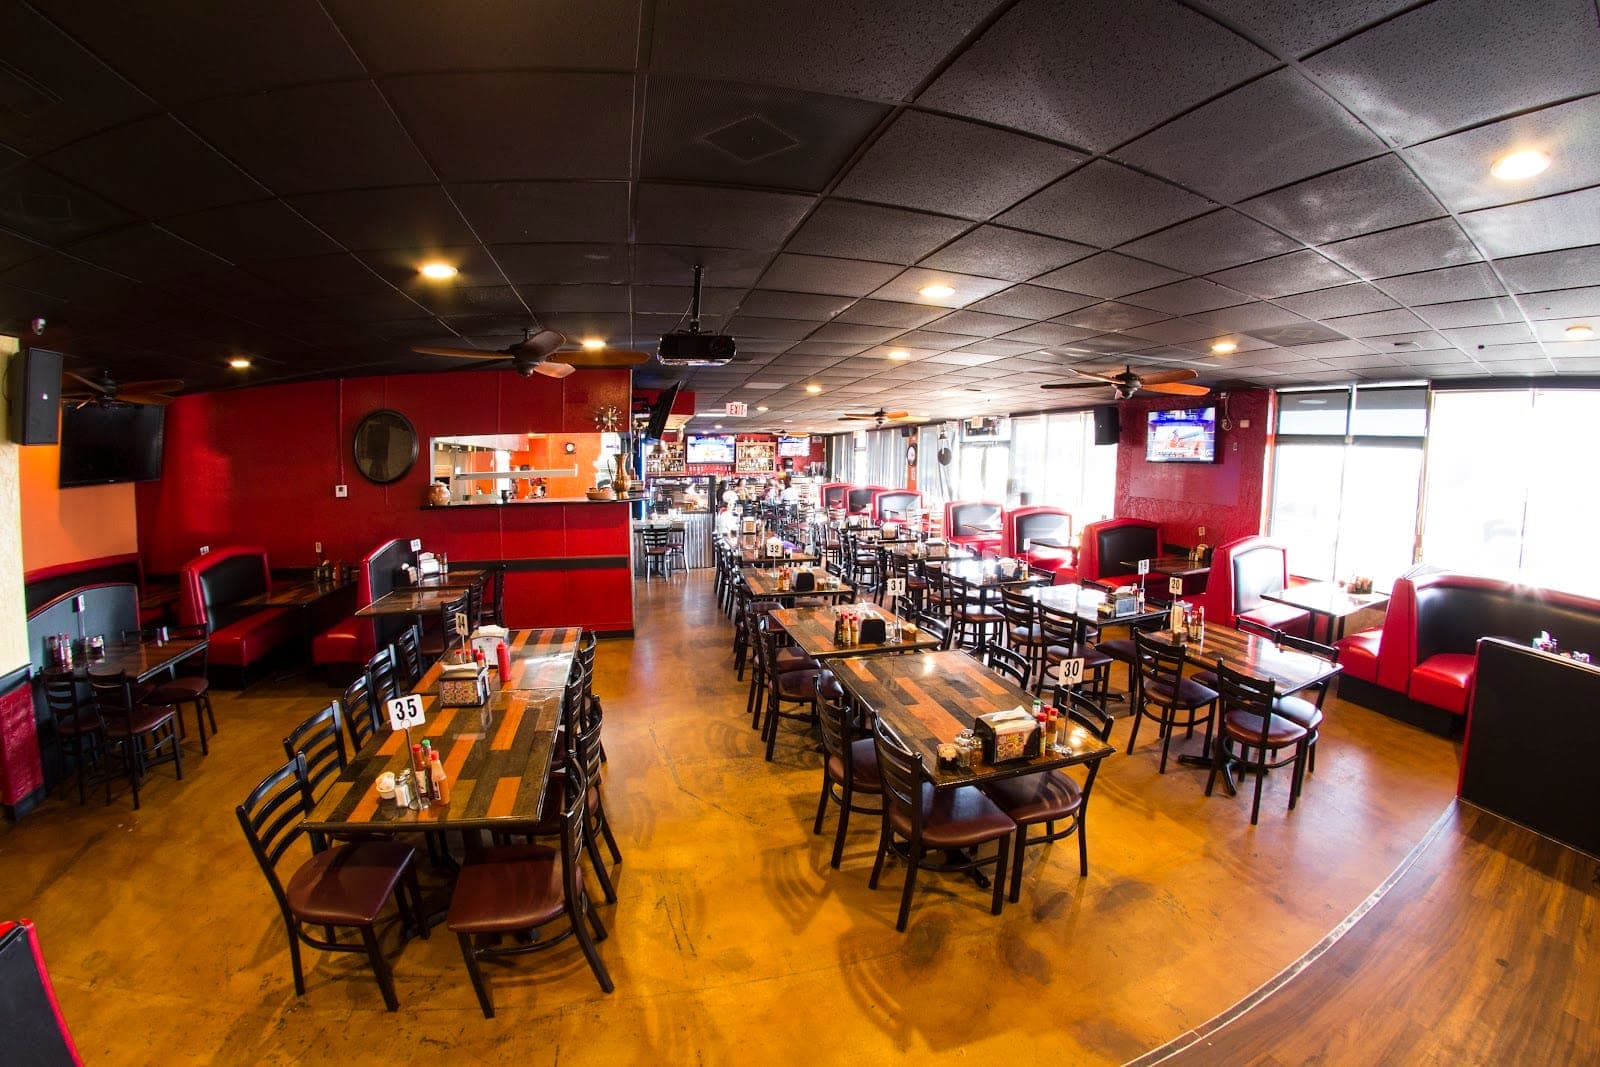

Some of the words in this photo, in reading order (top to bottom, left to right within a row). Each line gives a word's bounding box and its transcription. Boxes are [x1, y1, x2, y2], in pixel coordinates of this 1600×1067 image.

[729, 404, 746, 415] EXIT
[890, 580, 903, 591] 31
[1064, 661, 1079, 677] 30
[395, 698, 417, 720] 35
